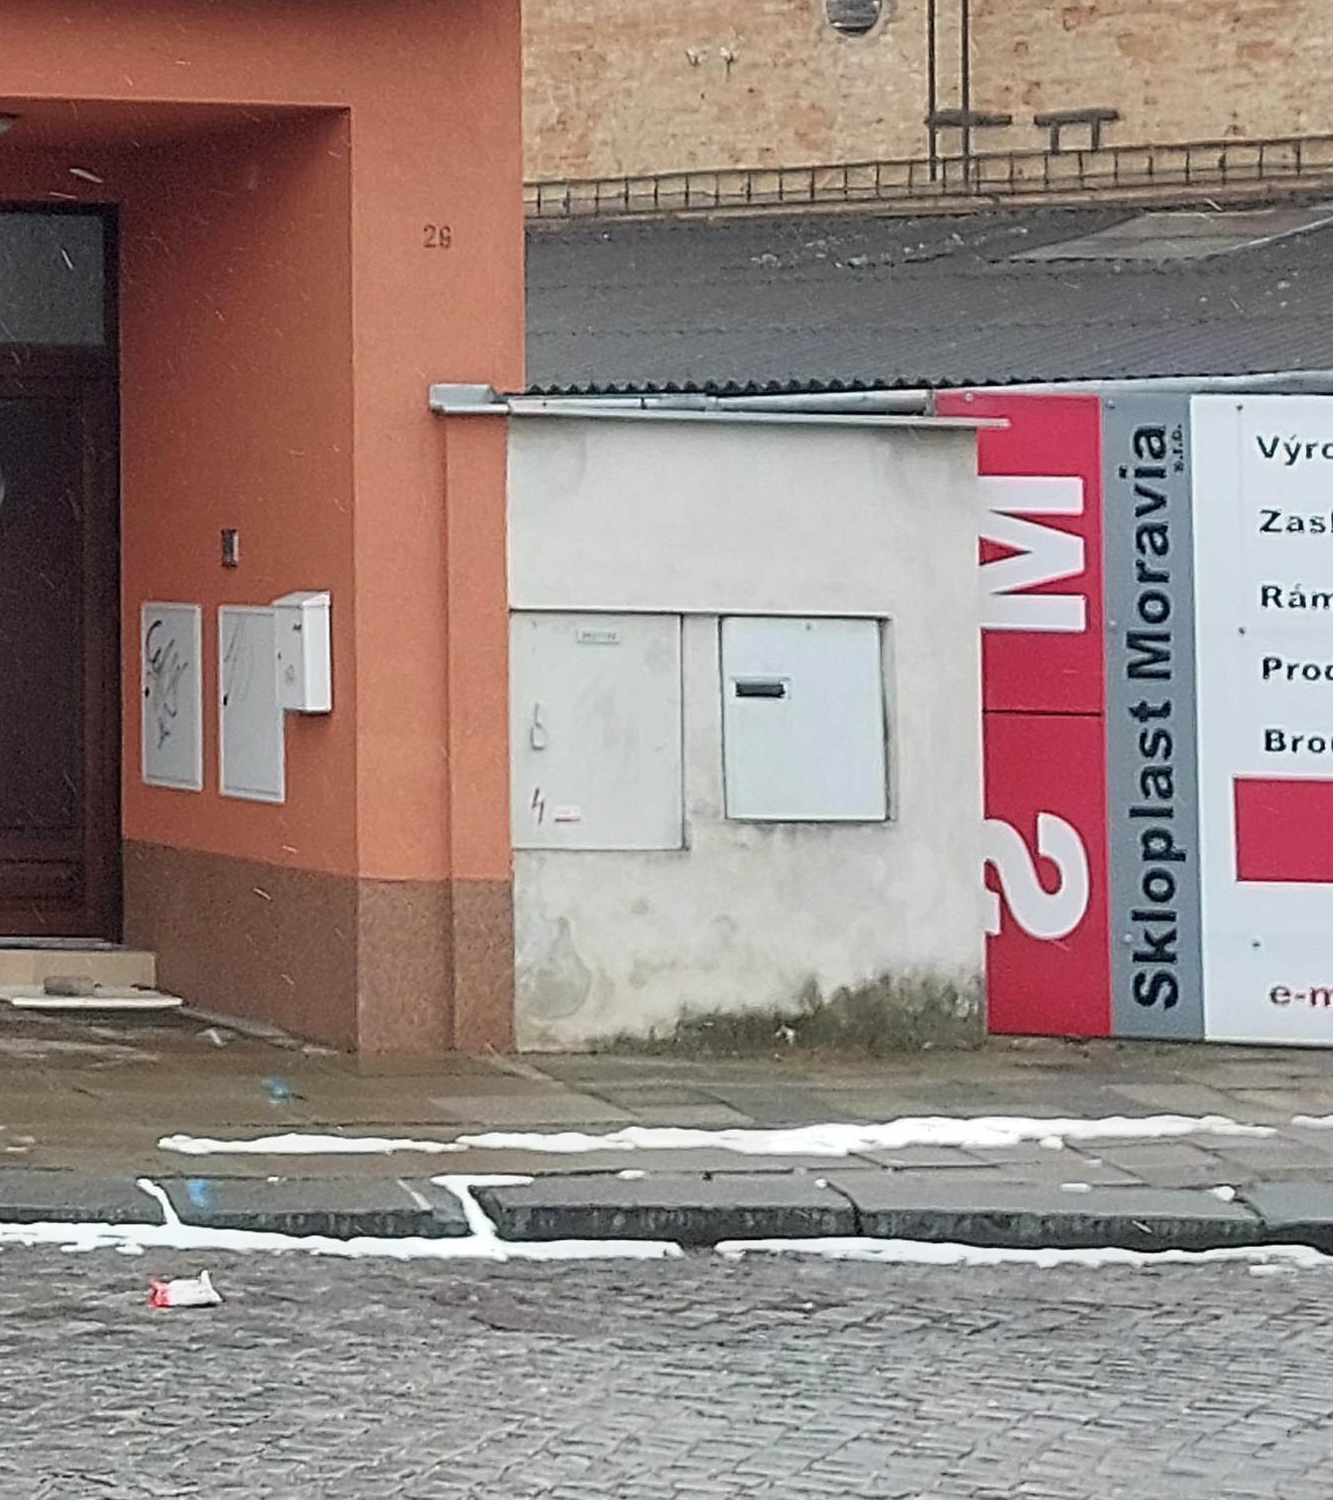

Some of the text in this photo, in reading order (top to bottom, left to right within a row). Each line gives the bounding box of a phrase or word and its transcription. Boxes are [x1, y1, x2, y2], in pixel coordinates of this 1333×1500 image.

[1259, 509, 1333, 533] Zas
[1119, 426, 1186, 1011] Skloplast Moravia
[1264, 729, 1333, 753] Bro
